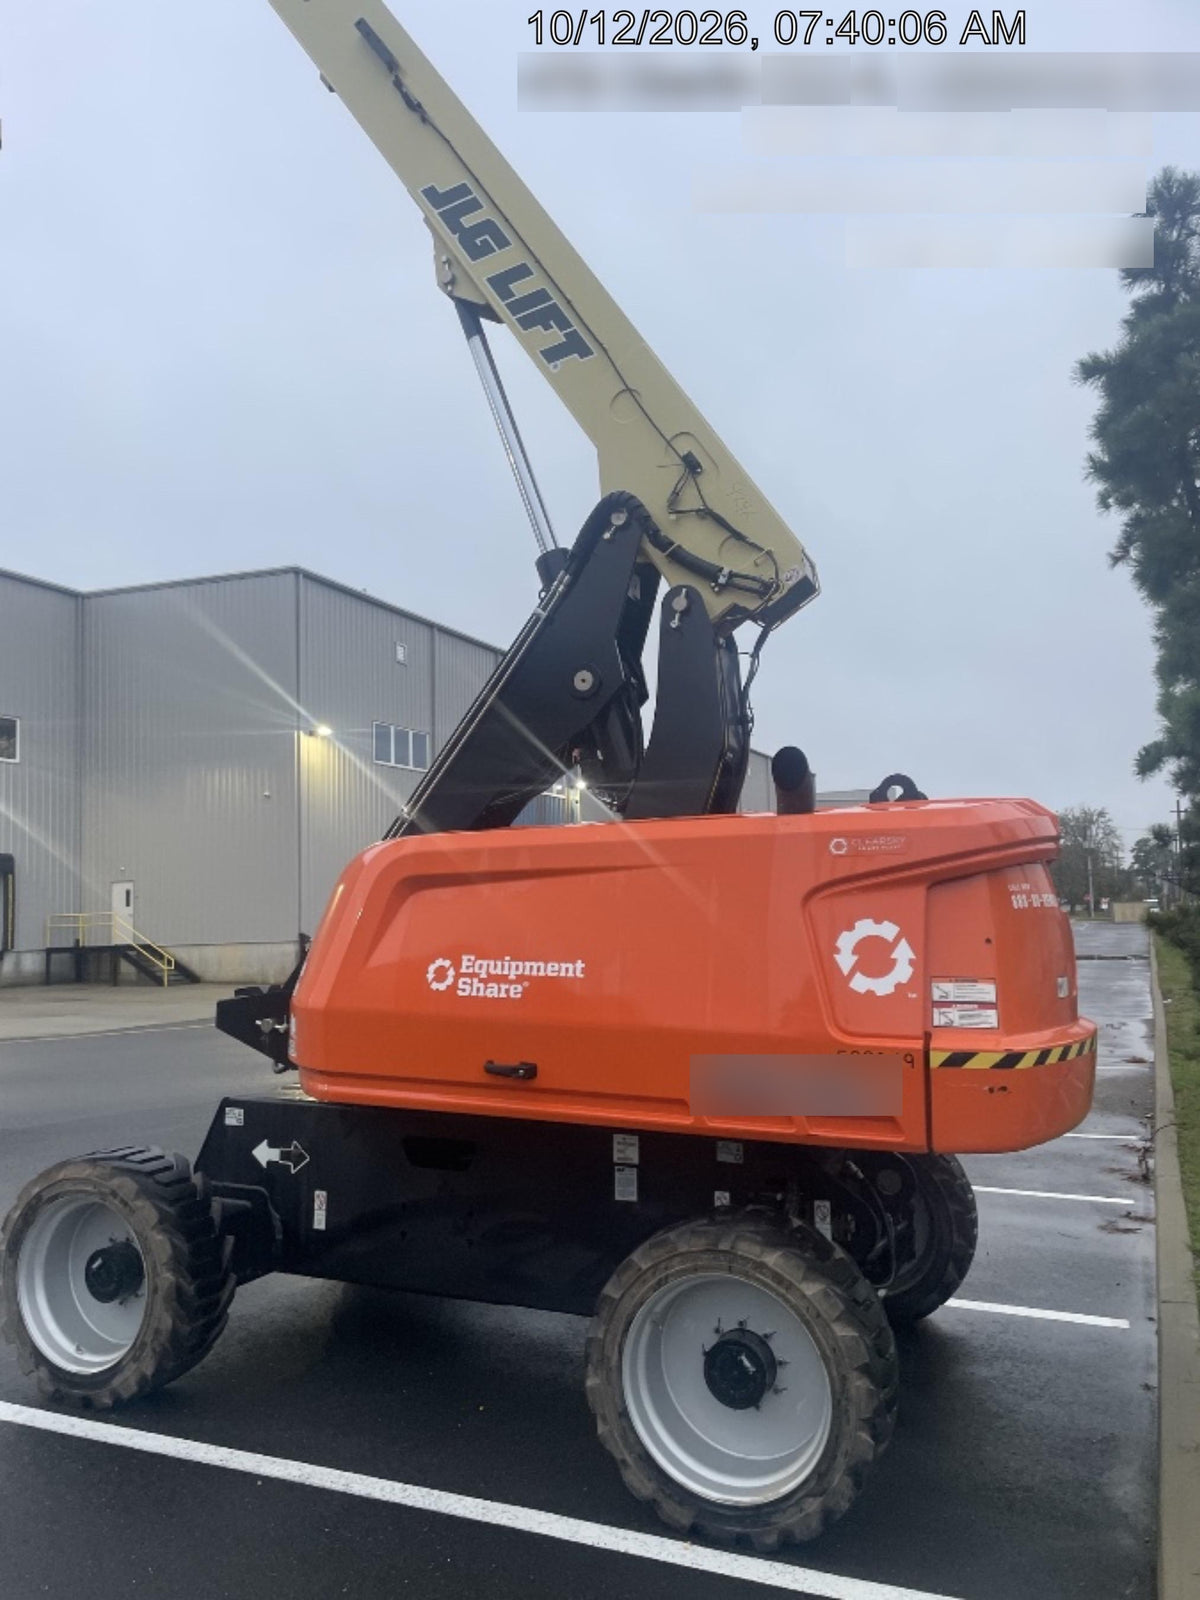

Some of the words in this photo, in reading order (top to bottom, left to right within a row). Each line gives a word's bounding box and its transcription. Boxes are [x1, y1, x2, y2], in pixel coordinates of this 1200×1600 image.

[420, 181, 513, 263] JLG
[485, 262, 595, 365] LIFT
[460, 954, 585, 979] Equipment
